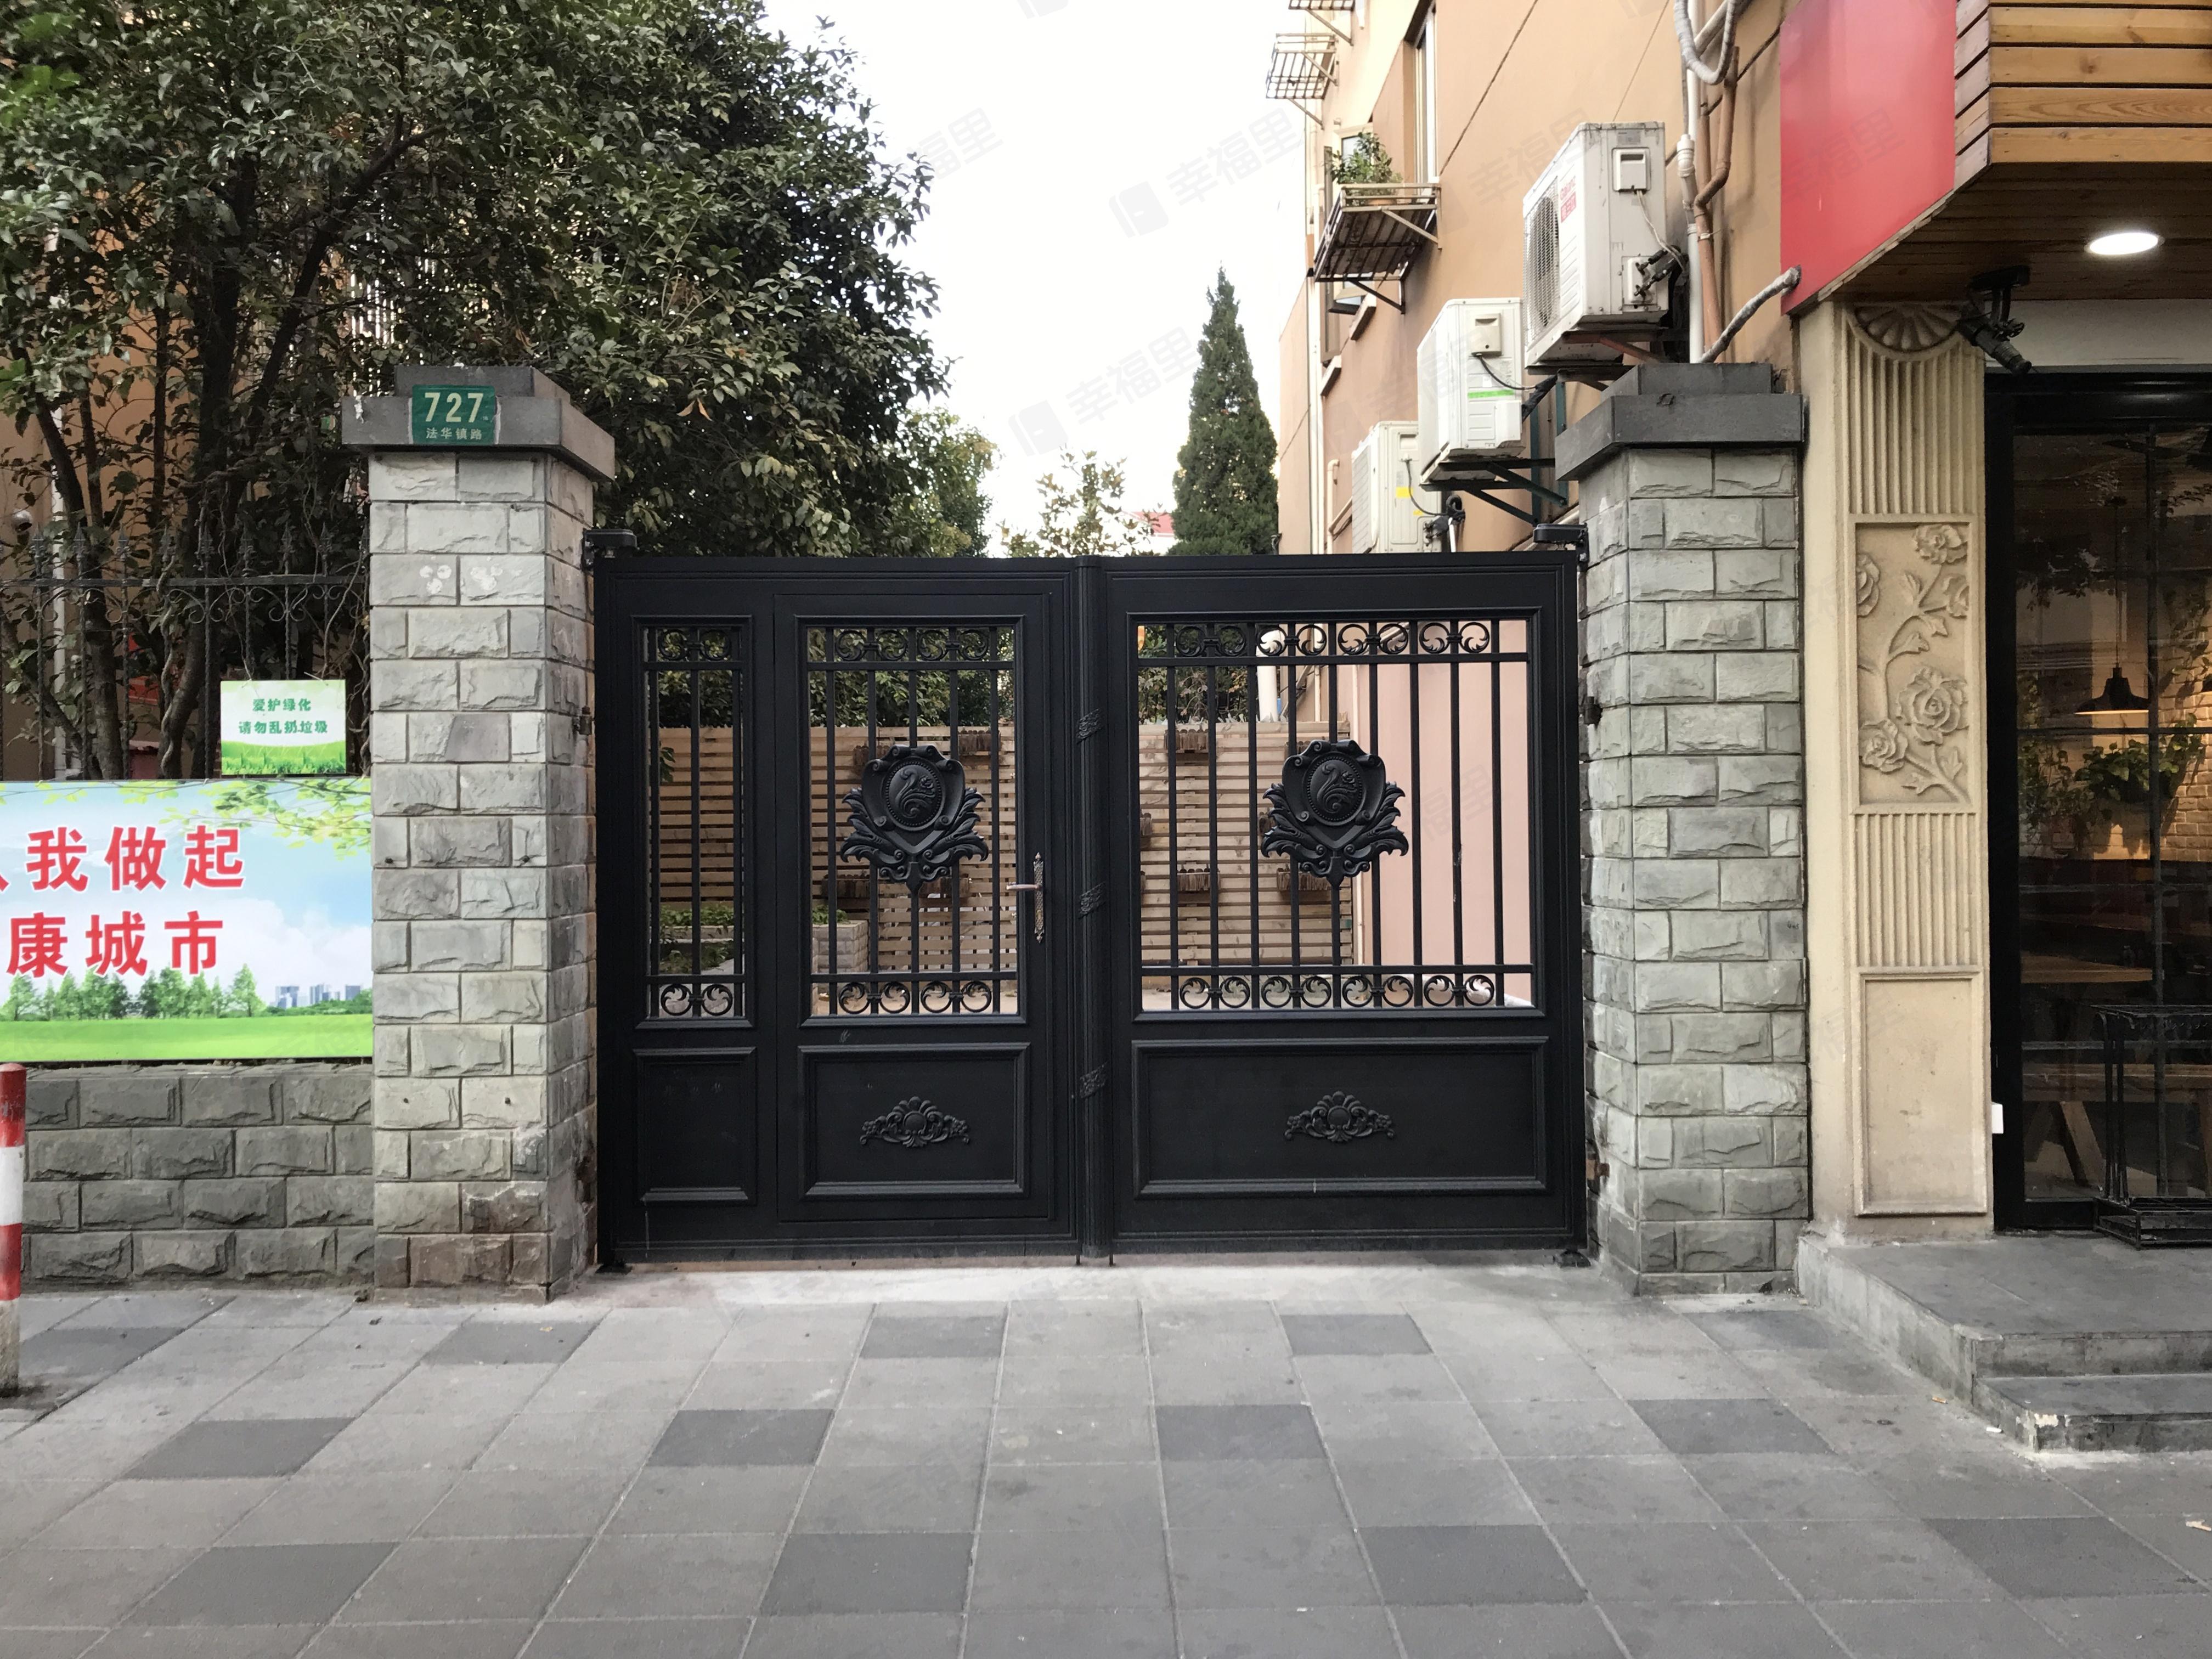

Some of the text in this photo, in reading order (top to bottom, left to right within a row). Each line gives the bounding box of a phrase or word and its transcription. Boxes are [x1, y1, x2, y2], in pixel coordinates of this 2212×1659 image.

[425, 392, 483, 422] 727
[426, 427, 482, 439] 法华镇路
[253, 698, 311, 712] 爱护绿化
[239, 720, 328, 734] 请勿乱扔垃圾
[0, 826, 244, 892] 我做起
[7, 911, 223, 978] 康城市
